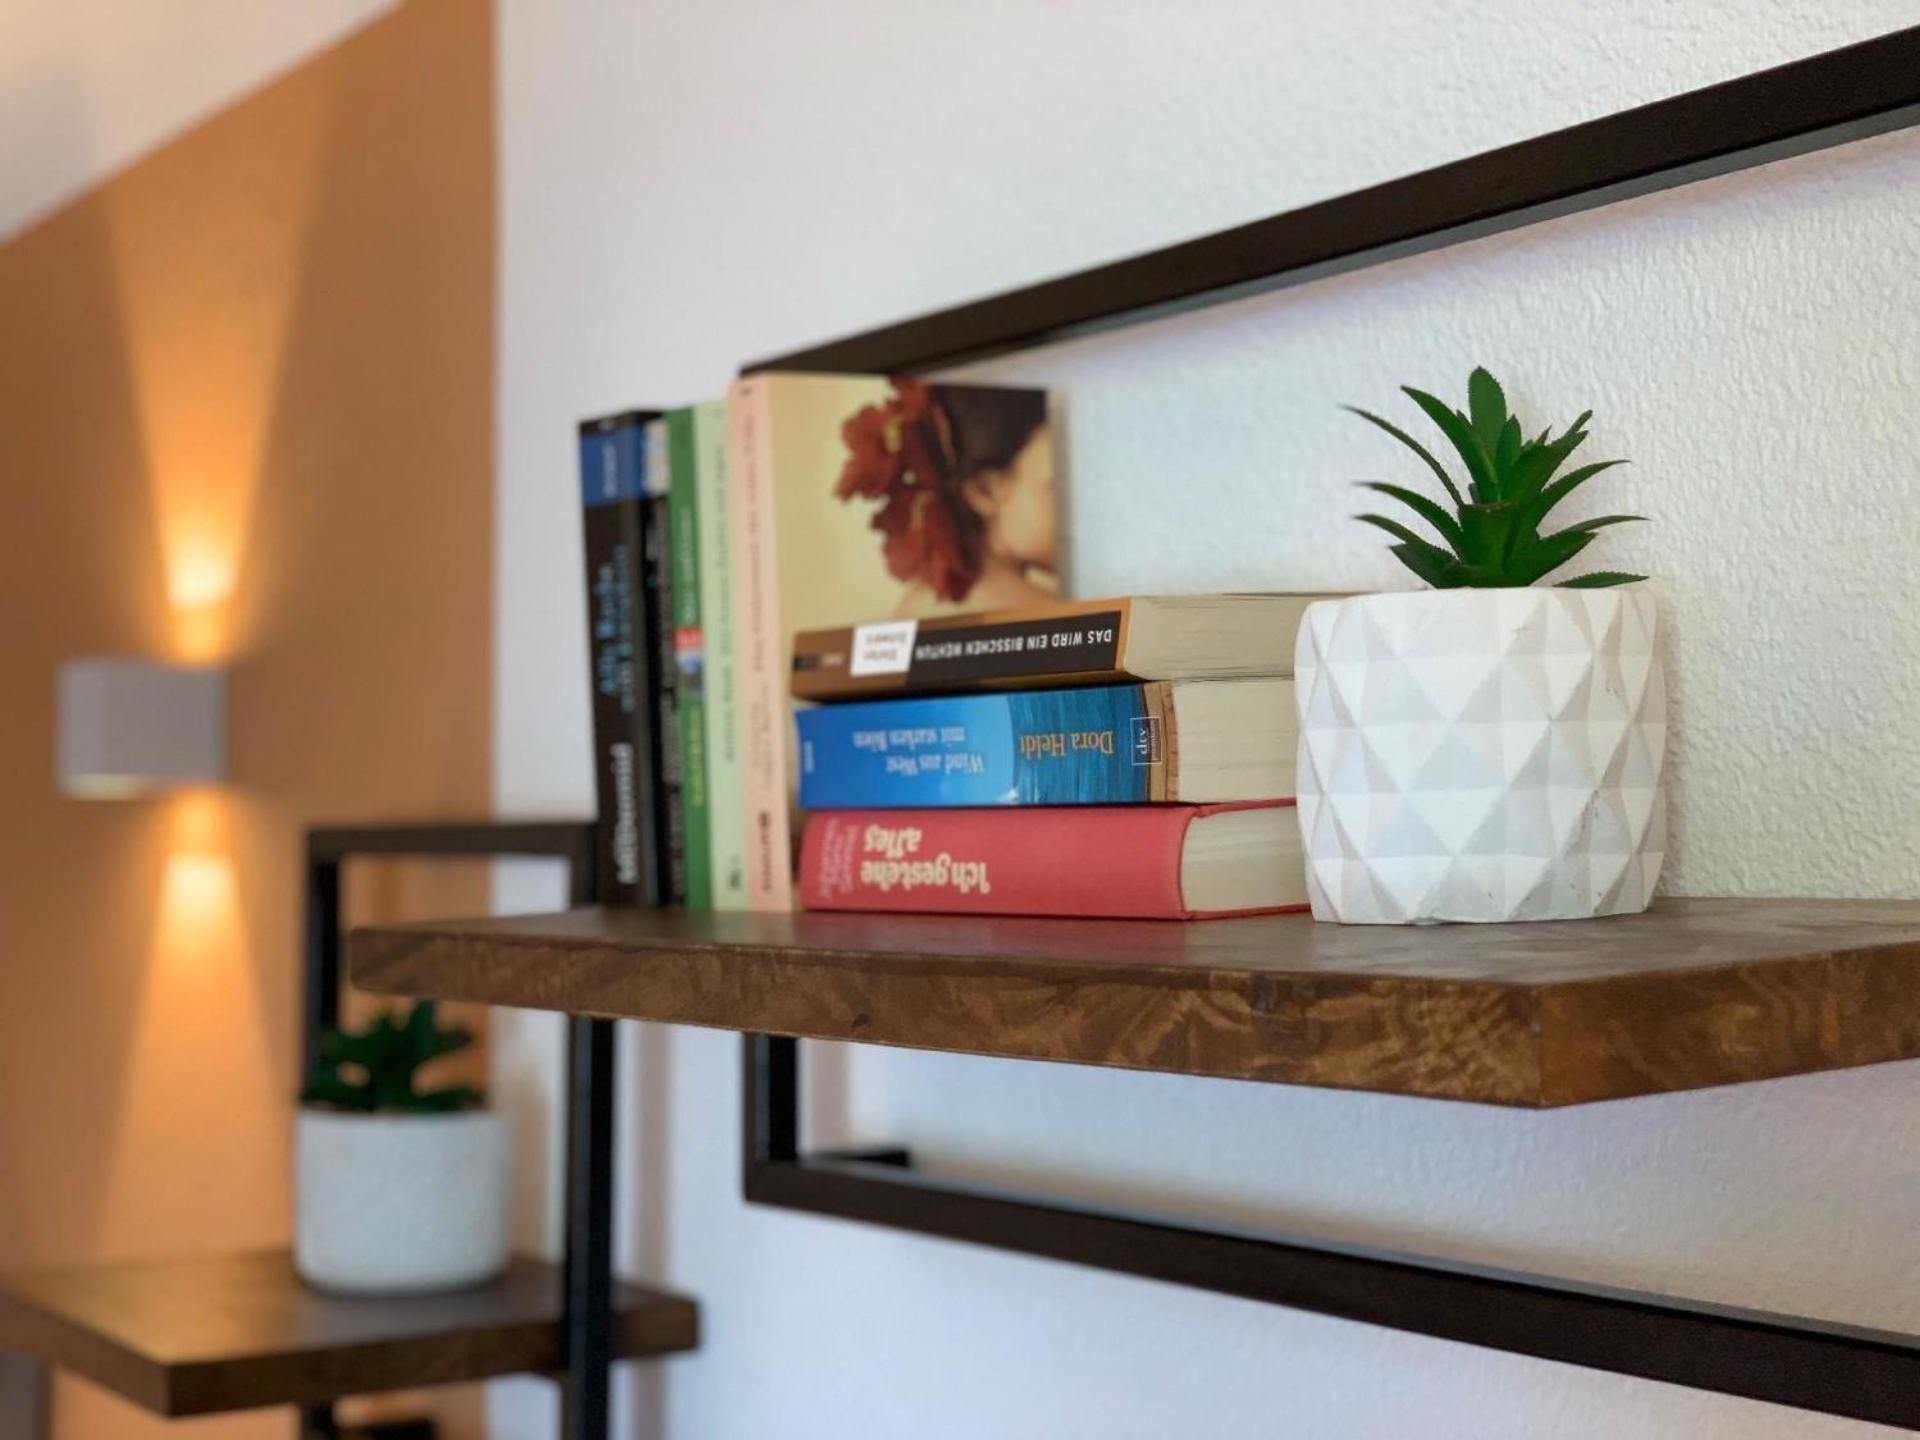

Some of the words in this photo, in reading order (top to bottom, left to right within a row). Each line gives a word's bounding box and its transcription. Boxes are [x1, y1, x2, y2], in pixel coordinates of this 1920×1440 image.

[964, 635, 1023, 655] BISSCHEN
[1026, 633, 1048, 650] EIN
[1051, 630, 1083, 647] WIRD
[1087, 628, 1112, 644] DAS
[889, 729, 938, 750] starken
[942, 727, 966, 747] mit
[1019, 732, 1067, 760] Heldt
[1070, 731, 1114, 754] Dora
[886, 755, 918, 776] West
[919, 754, 942, 772] aus
[944, 753, 985, 775] Wind
[863, 824, 923, 859] alles
[860, 852, 951, 892] gestehe
[951, 862, 991, 894] Ich
